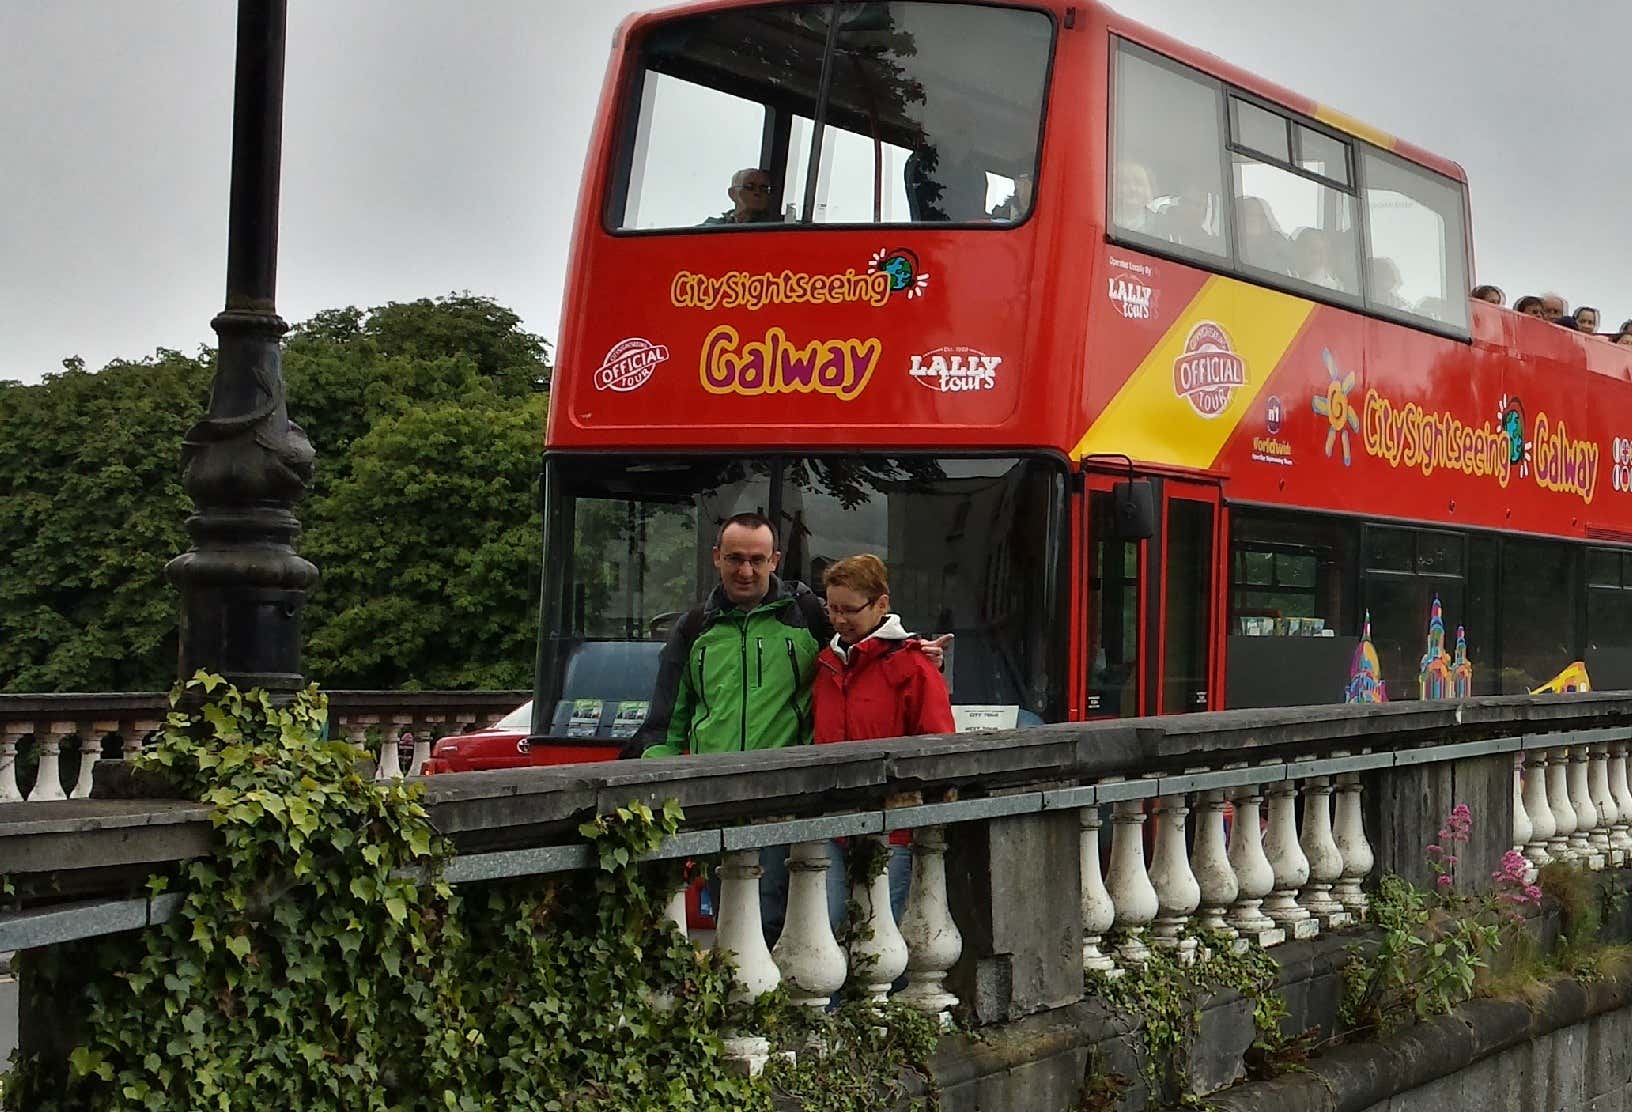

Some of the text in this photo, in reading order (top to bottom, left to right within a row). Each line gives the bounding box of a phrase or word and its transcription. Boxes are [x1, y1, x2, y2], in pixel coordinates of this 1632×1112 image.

[1108, 277, 1152, 306] LALLY
[602, 347, 665, 383] OFFICIAL
[700, 324, 882, 401] Galway
[909, 355, 1002, 377] LALLY
[1180, 357, 1240, 390] OFFICIAL
[621, 368, 650, 387] TOUR
[939, 374, 995, 393] tours
[1199, 388, 1227, 412] TOUR
[1533, 411, 1599, 505] Galway
